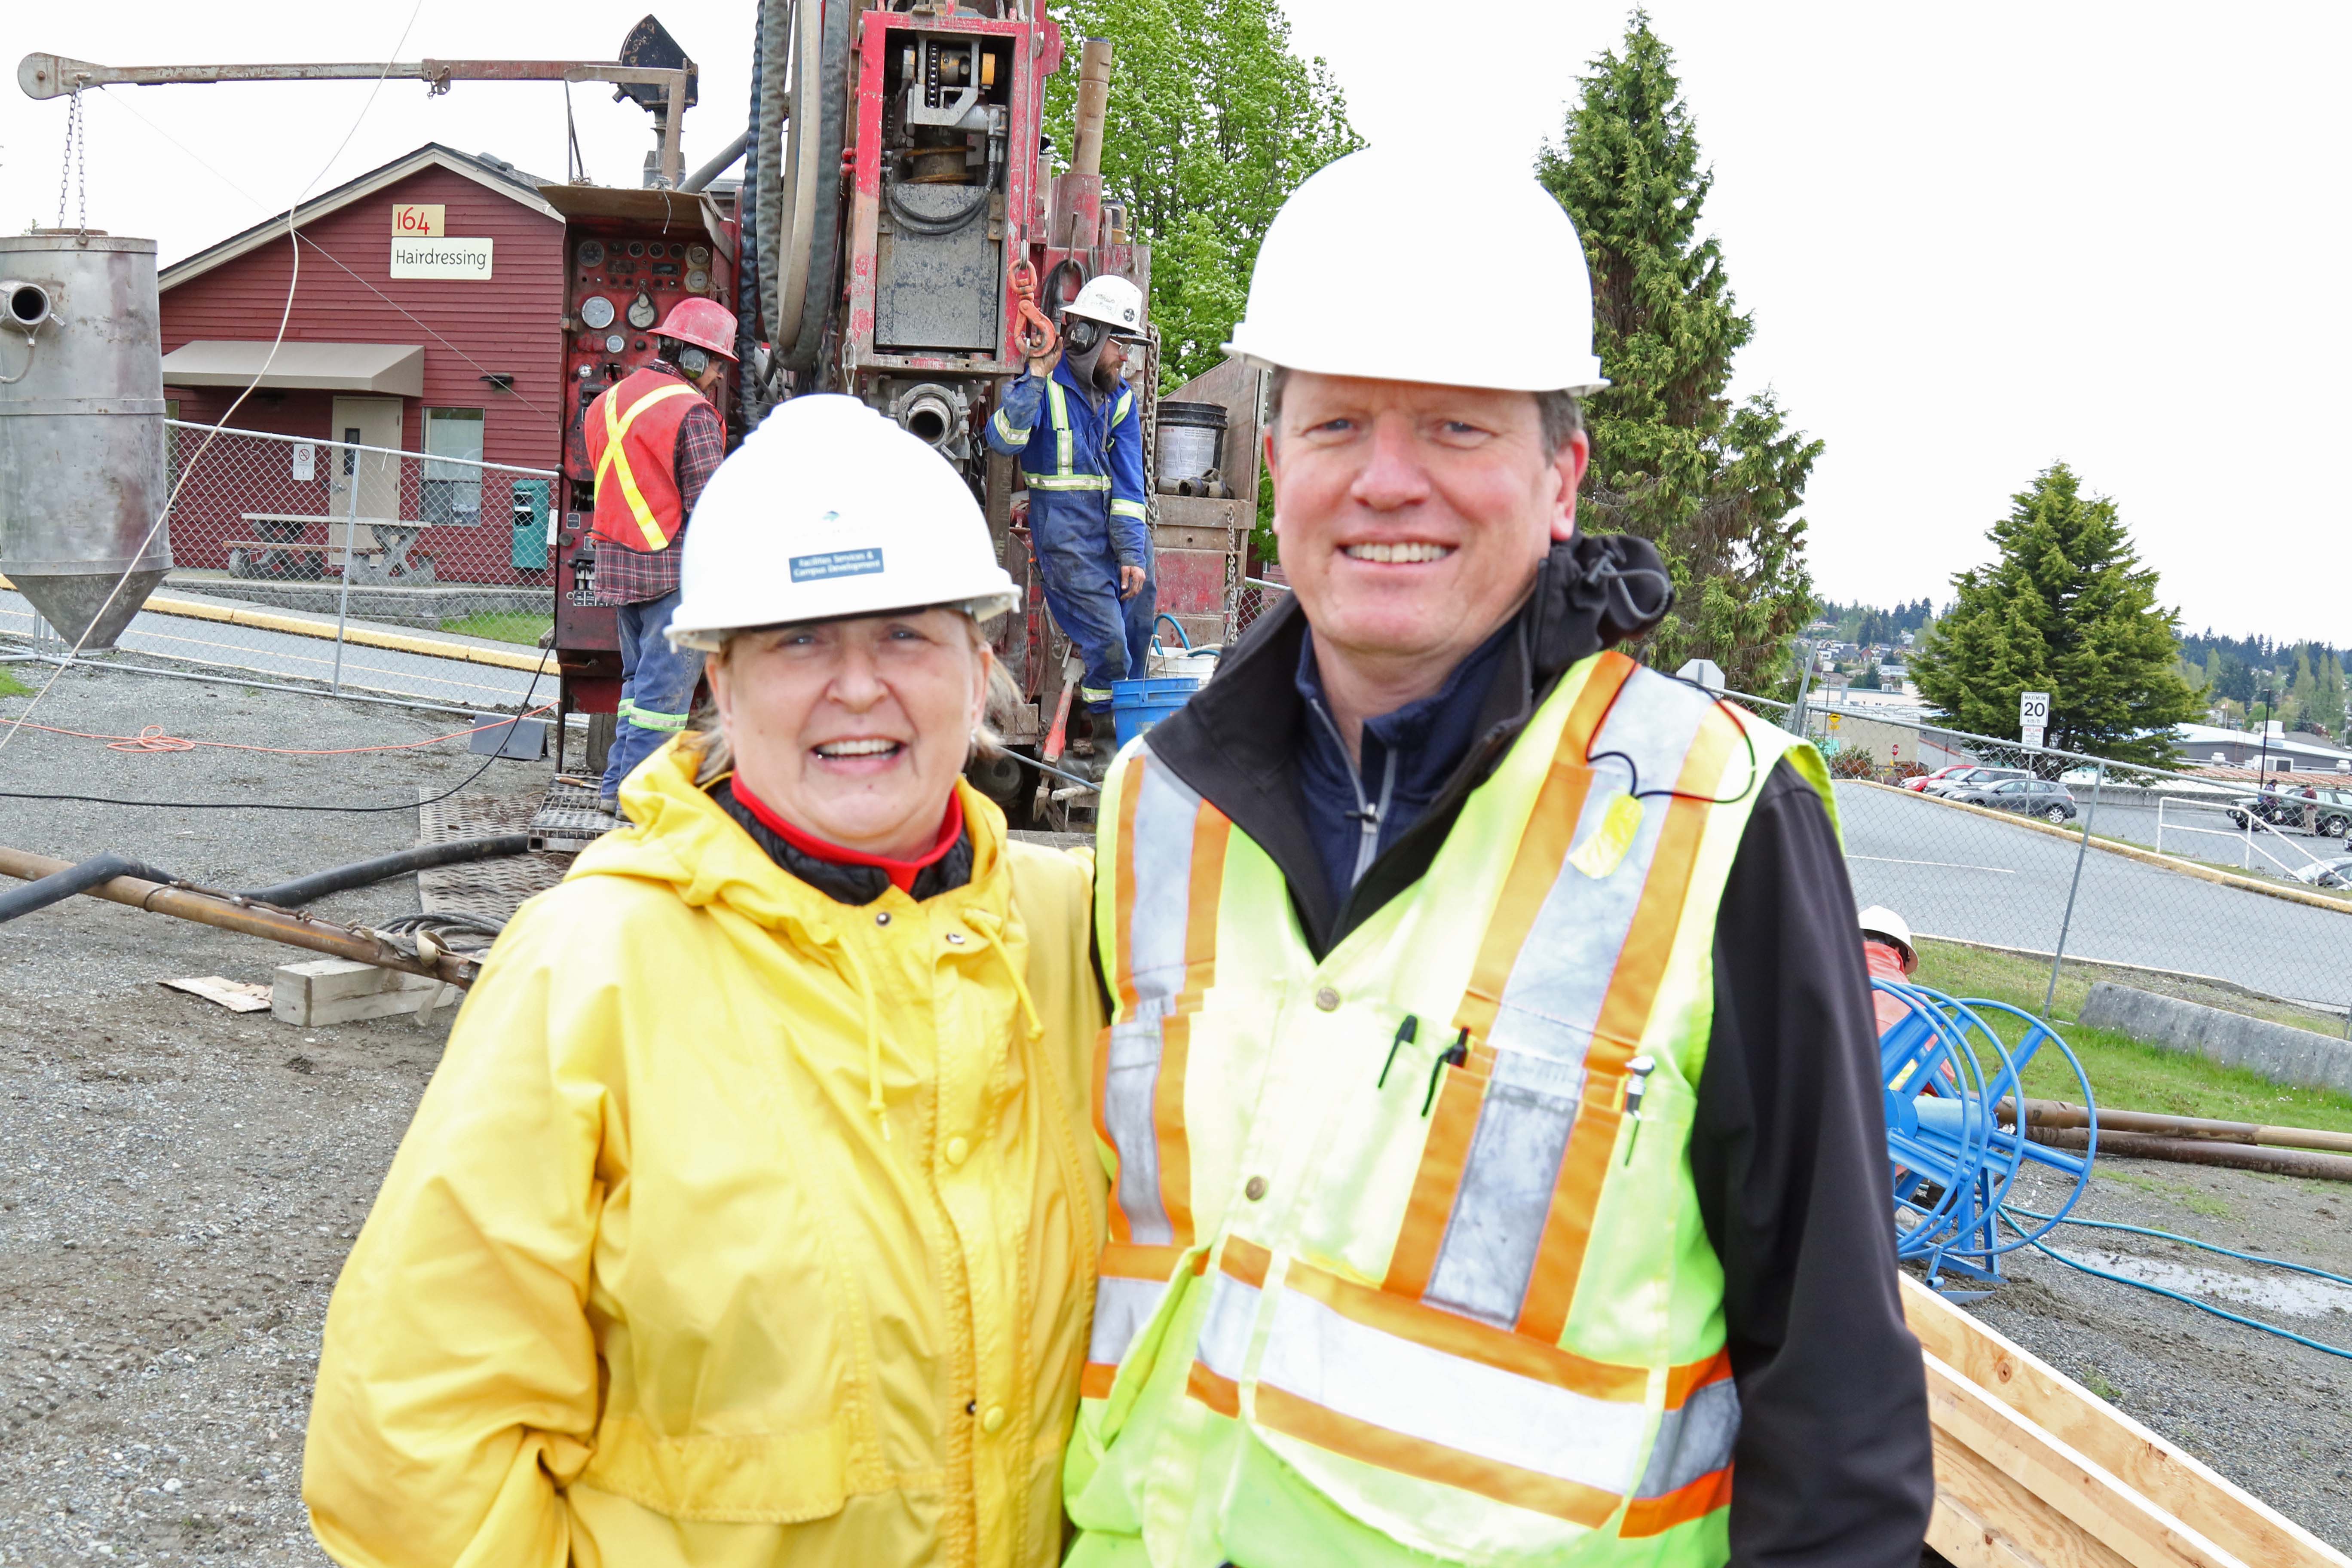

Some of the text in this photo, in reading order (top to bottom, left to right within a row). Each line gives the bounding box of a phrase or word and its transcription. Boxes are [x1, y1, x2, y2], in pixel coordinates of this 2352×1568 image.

[397, 206, 430, 235] 164
[396, 248, 487, 270] Hairdressing
[833, 552, 866, 564] Services
[866, 551, 874, 560] &
[793, 560, 880, 577] Campus Development
[2024, 702, 2045, 717] 20
